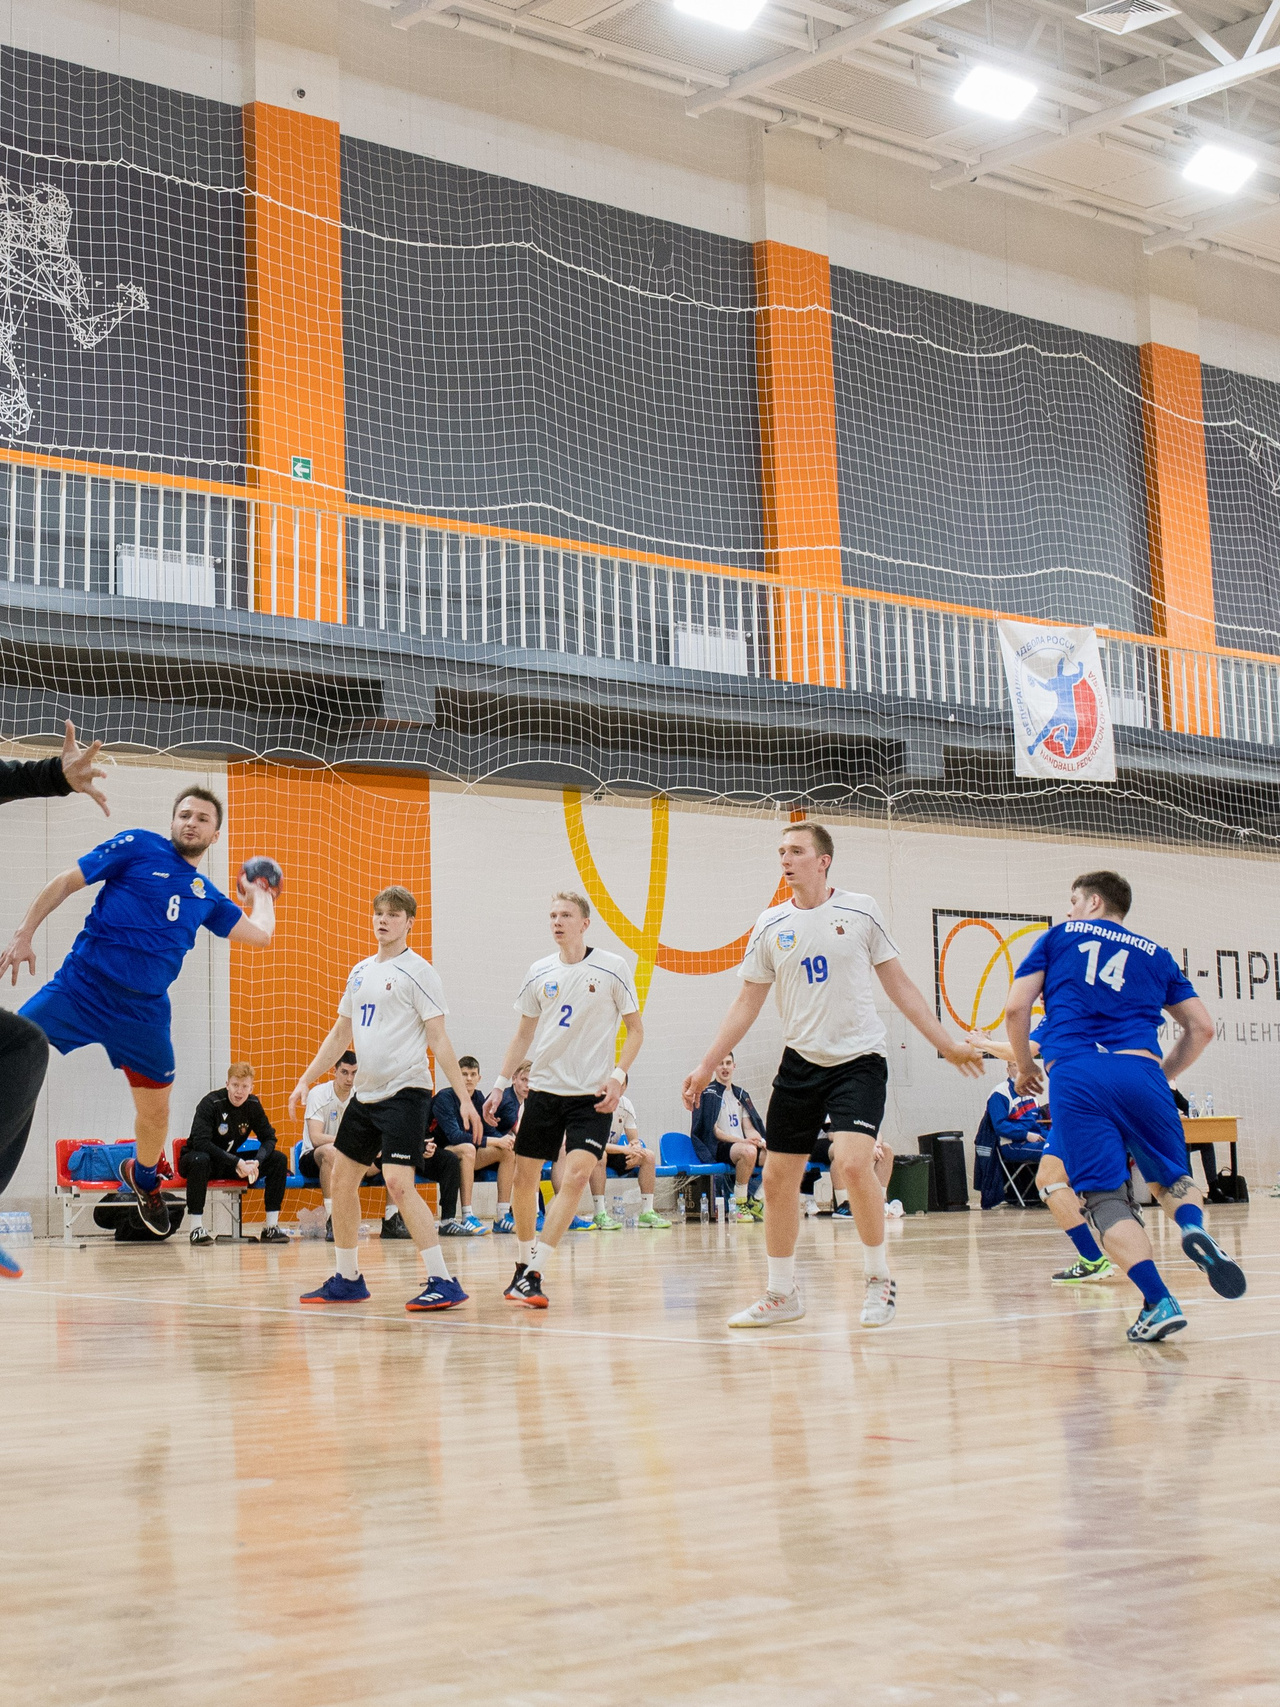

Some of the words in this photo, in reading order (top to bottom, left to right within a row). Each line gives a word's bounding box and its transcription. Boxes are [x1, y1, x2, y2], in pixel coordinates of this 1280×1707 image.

[1076, 726, 1105, 770] FEDERATION
[166, 895, 181, 921] 6
[1065, 921, 1157, 956] БАРАННИКОВ
[801, 955, 829, 984] 19
[1078, 940, 1129, 992] 14
[360, 1003, 376, 1027] 17
[559, 1004, 573, 1028] 2
